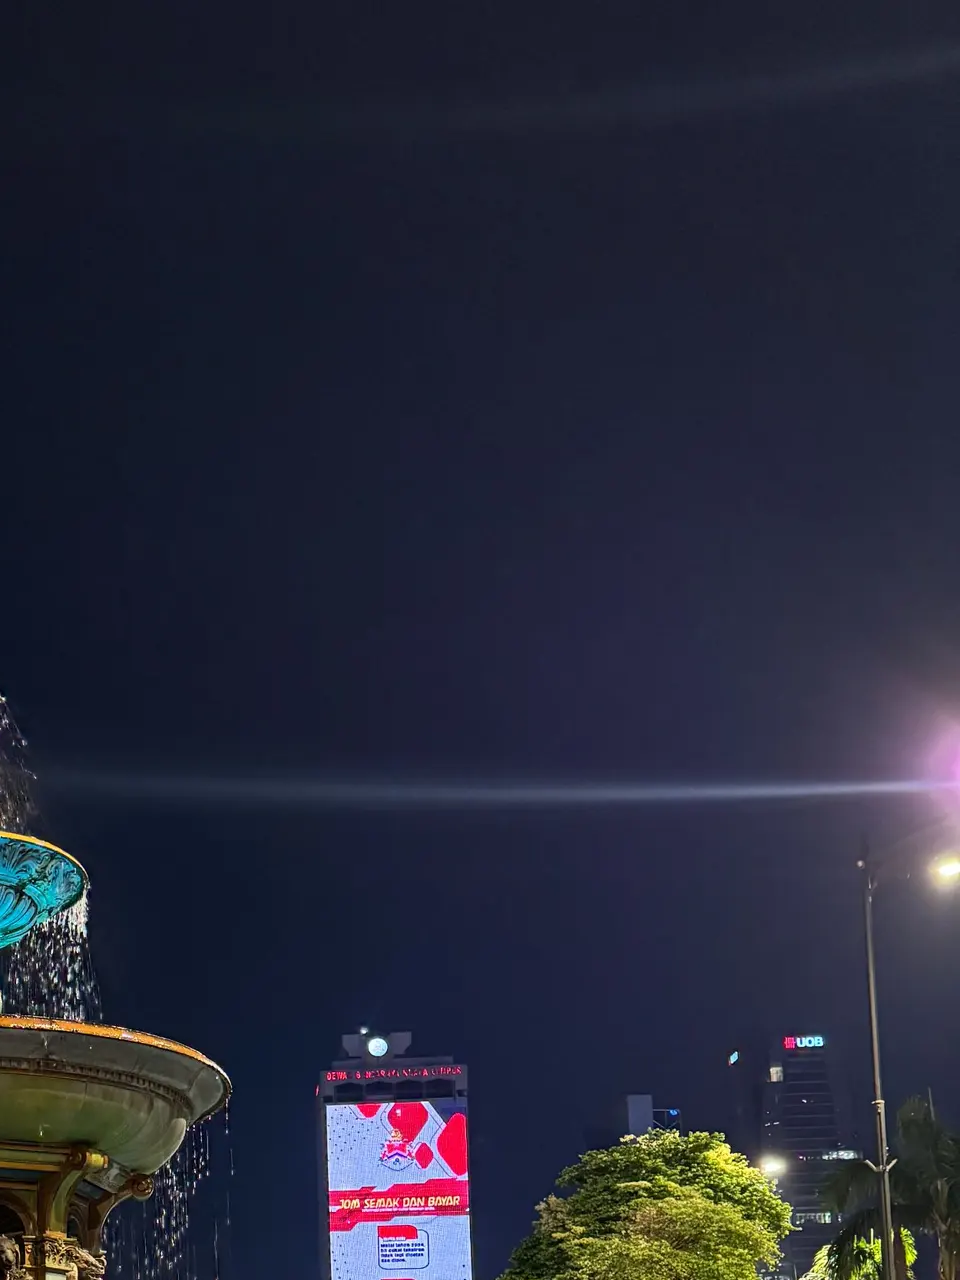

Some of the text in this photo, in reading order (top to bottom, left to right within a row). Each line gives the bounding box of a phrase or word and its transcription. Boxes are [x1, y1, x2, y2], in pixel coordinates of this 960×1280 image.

[796, 1036, 824, 1048] UOB
[339, 1195, 460, 1209] JOM SEMAK DAN BAYAR
